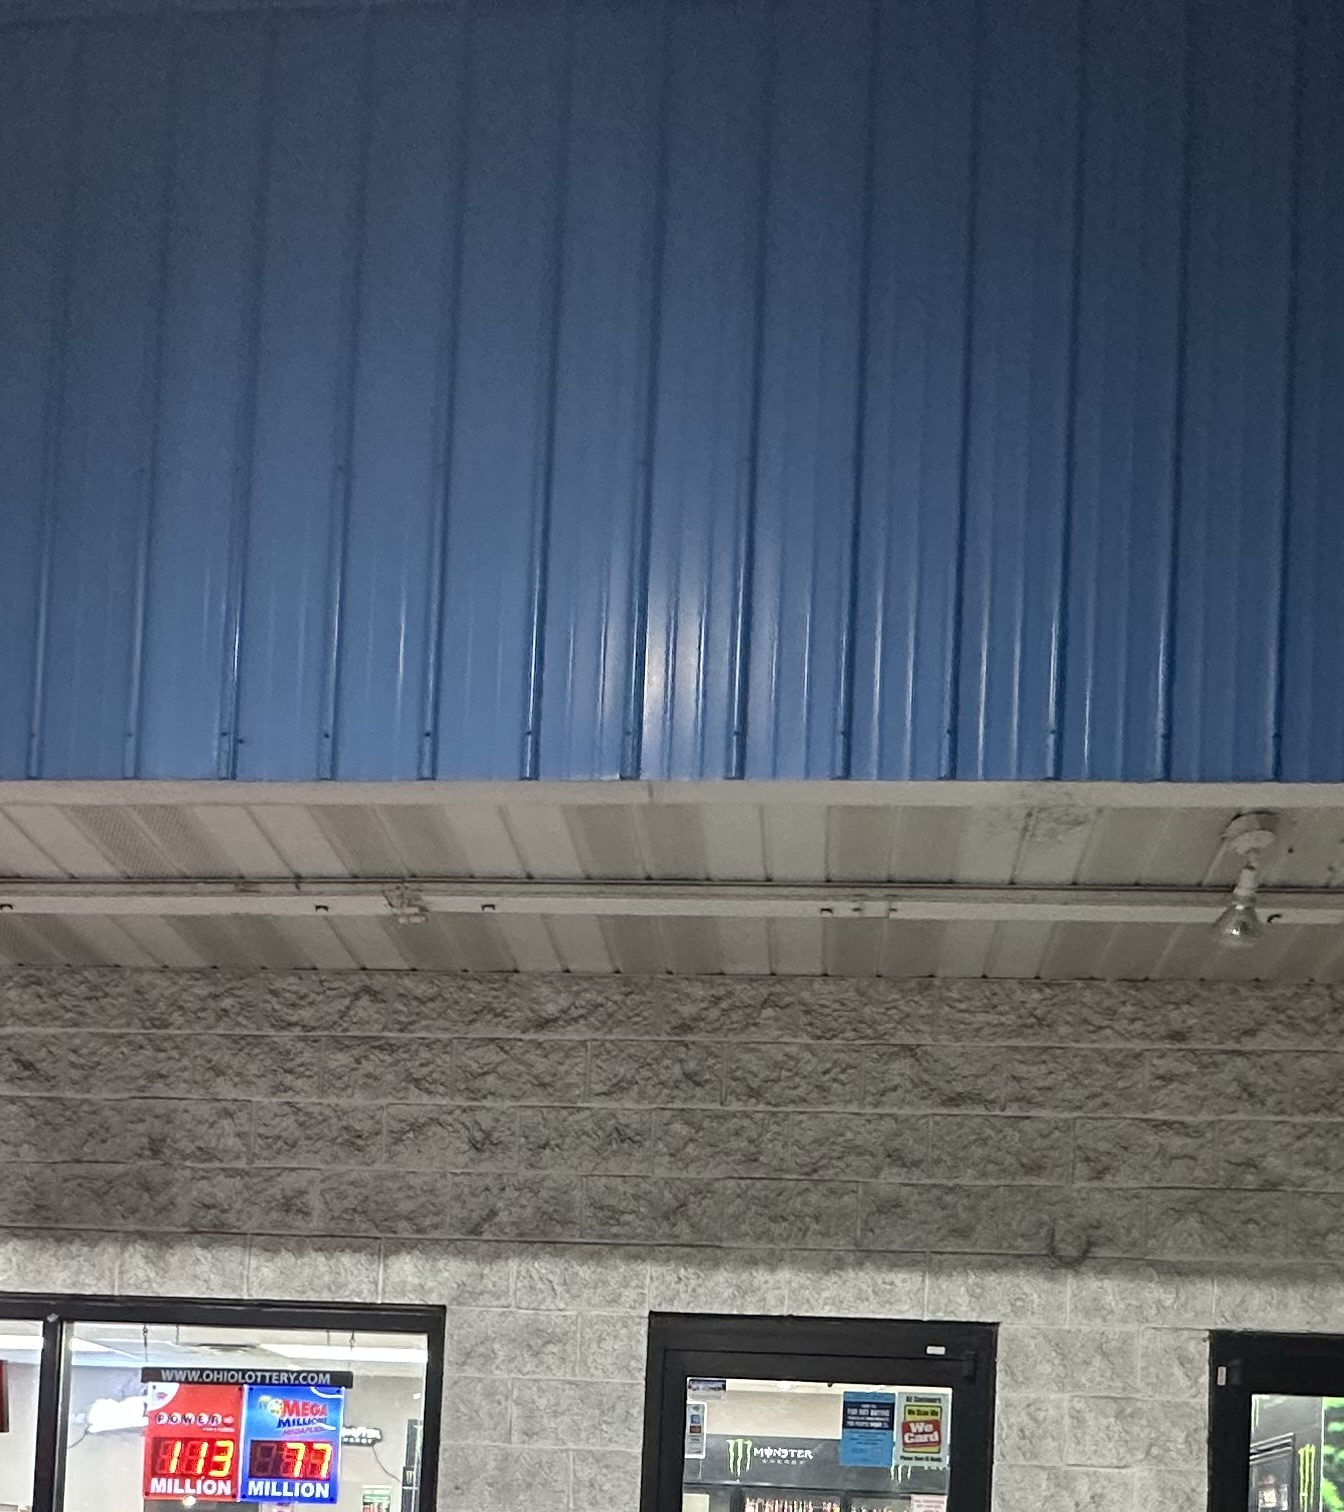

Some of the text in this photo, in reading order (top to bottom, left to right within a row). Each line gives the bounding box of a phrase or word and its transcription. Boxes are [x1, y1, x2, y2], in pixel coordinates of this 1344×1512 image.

[161, 1368, 331, 1385] WWW.OHIOLOTTERY.COM
[283, 1399, 328, 1418] MEGA
[909, 1422, 934, 1433] We
[903, 1431, 939, 1444] Card
[168, 1440, 234, 1478] 113
[286, 1442, 334, 1478] 77
[150, 1477, 232, 1496] MILLION
[247, 1481, 331, 1499] MILLION
